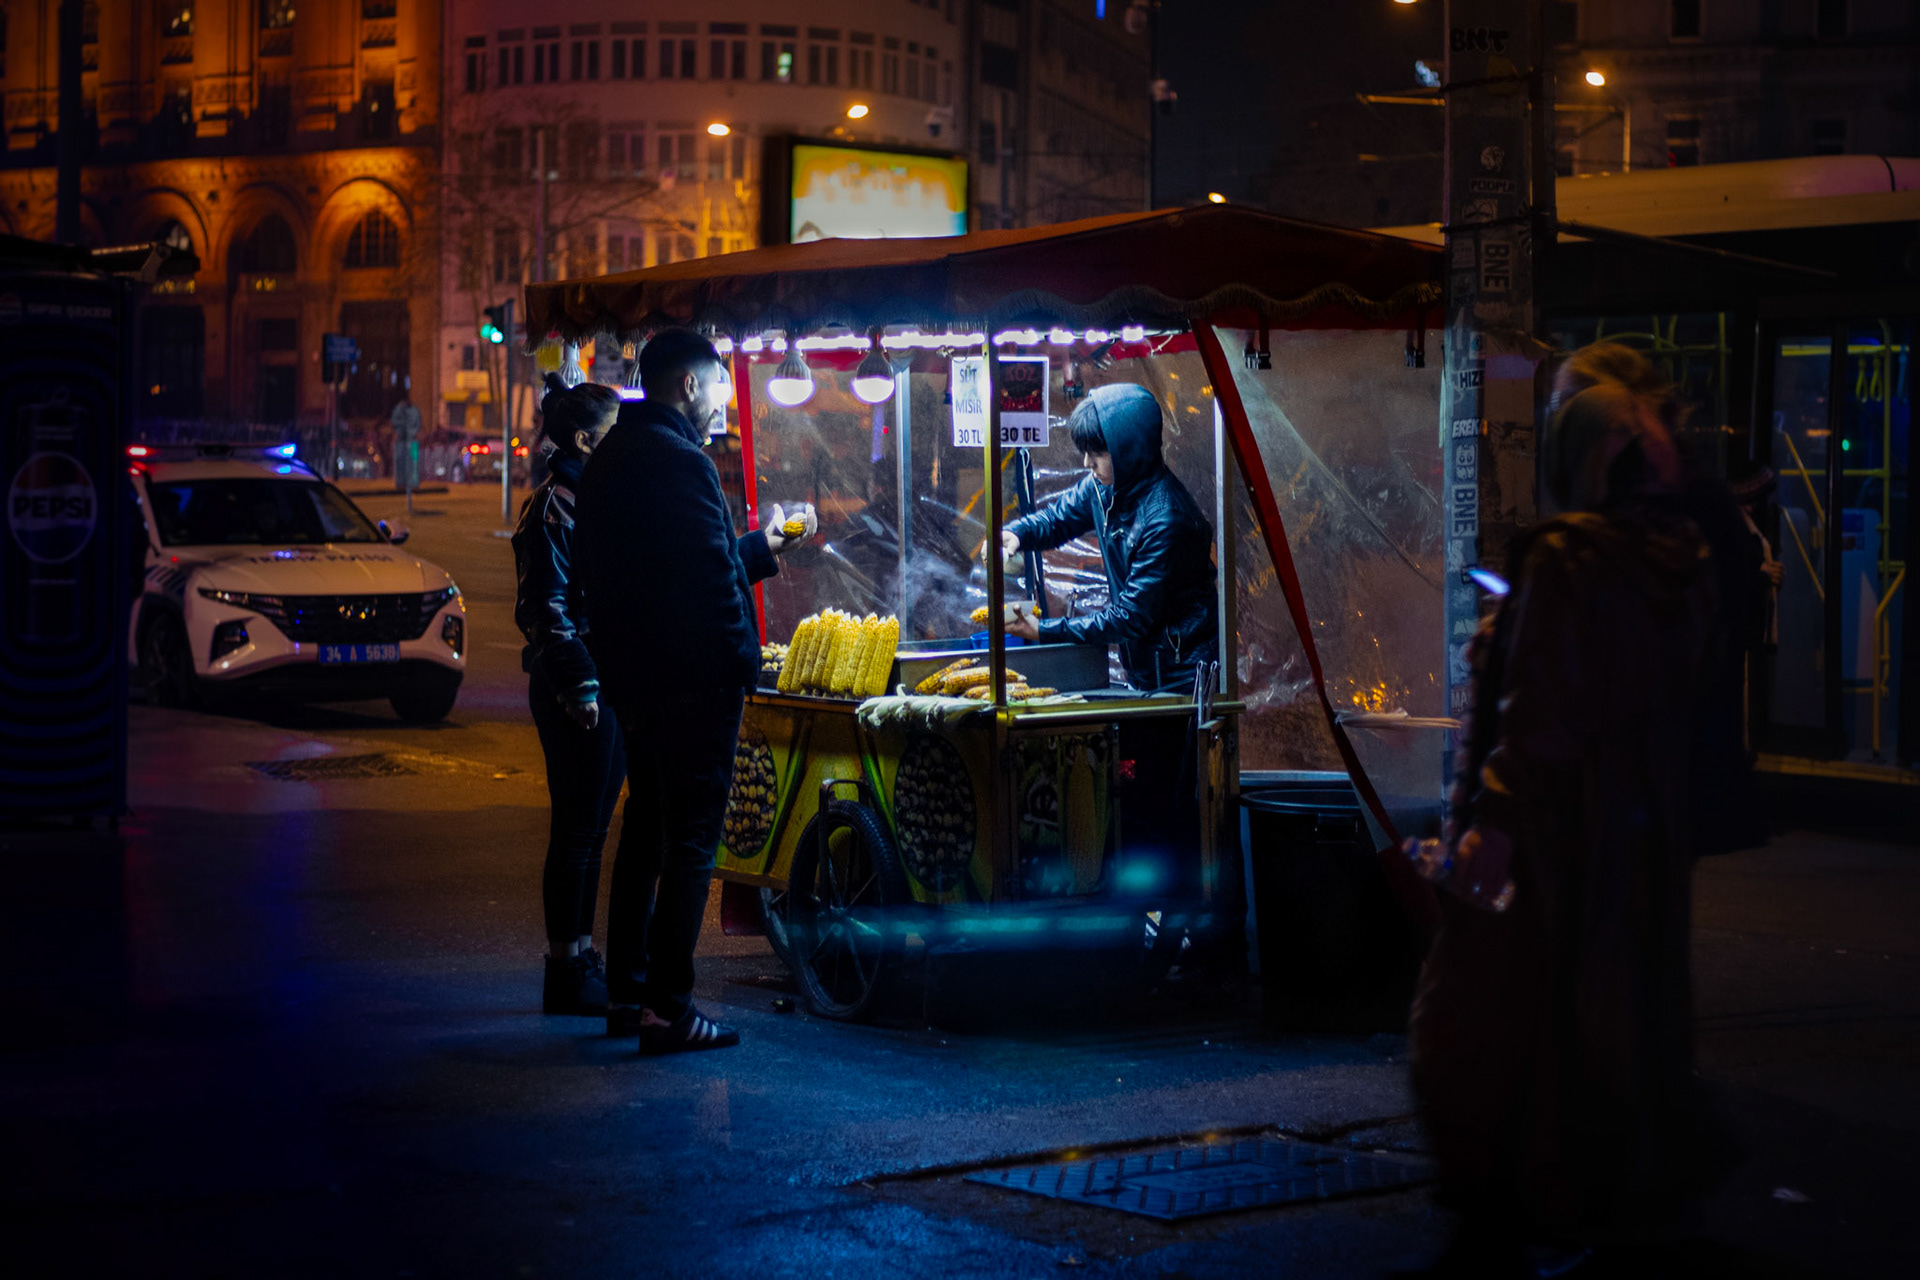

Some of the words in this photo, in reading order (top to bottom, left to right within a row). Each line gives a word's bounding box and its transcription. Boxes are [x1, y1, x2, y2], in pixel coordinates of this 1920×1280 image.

[1484, 243, 1510, 288] BNE
[959, 364, 978, 383] SÜT
[958, 429, 970, 444] 30
[971, 429, 982, 444] TL
[1000, 427, 1019, 442] 30
[14, 496, 91, 519] PEPSI
[1454, 488, 1476, 533] BNE
[326, 645, 341, 662] 34
[350, 644, 357, 661] A
